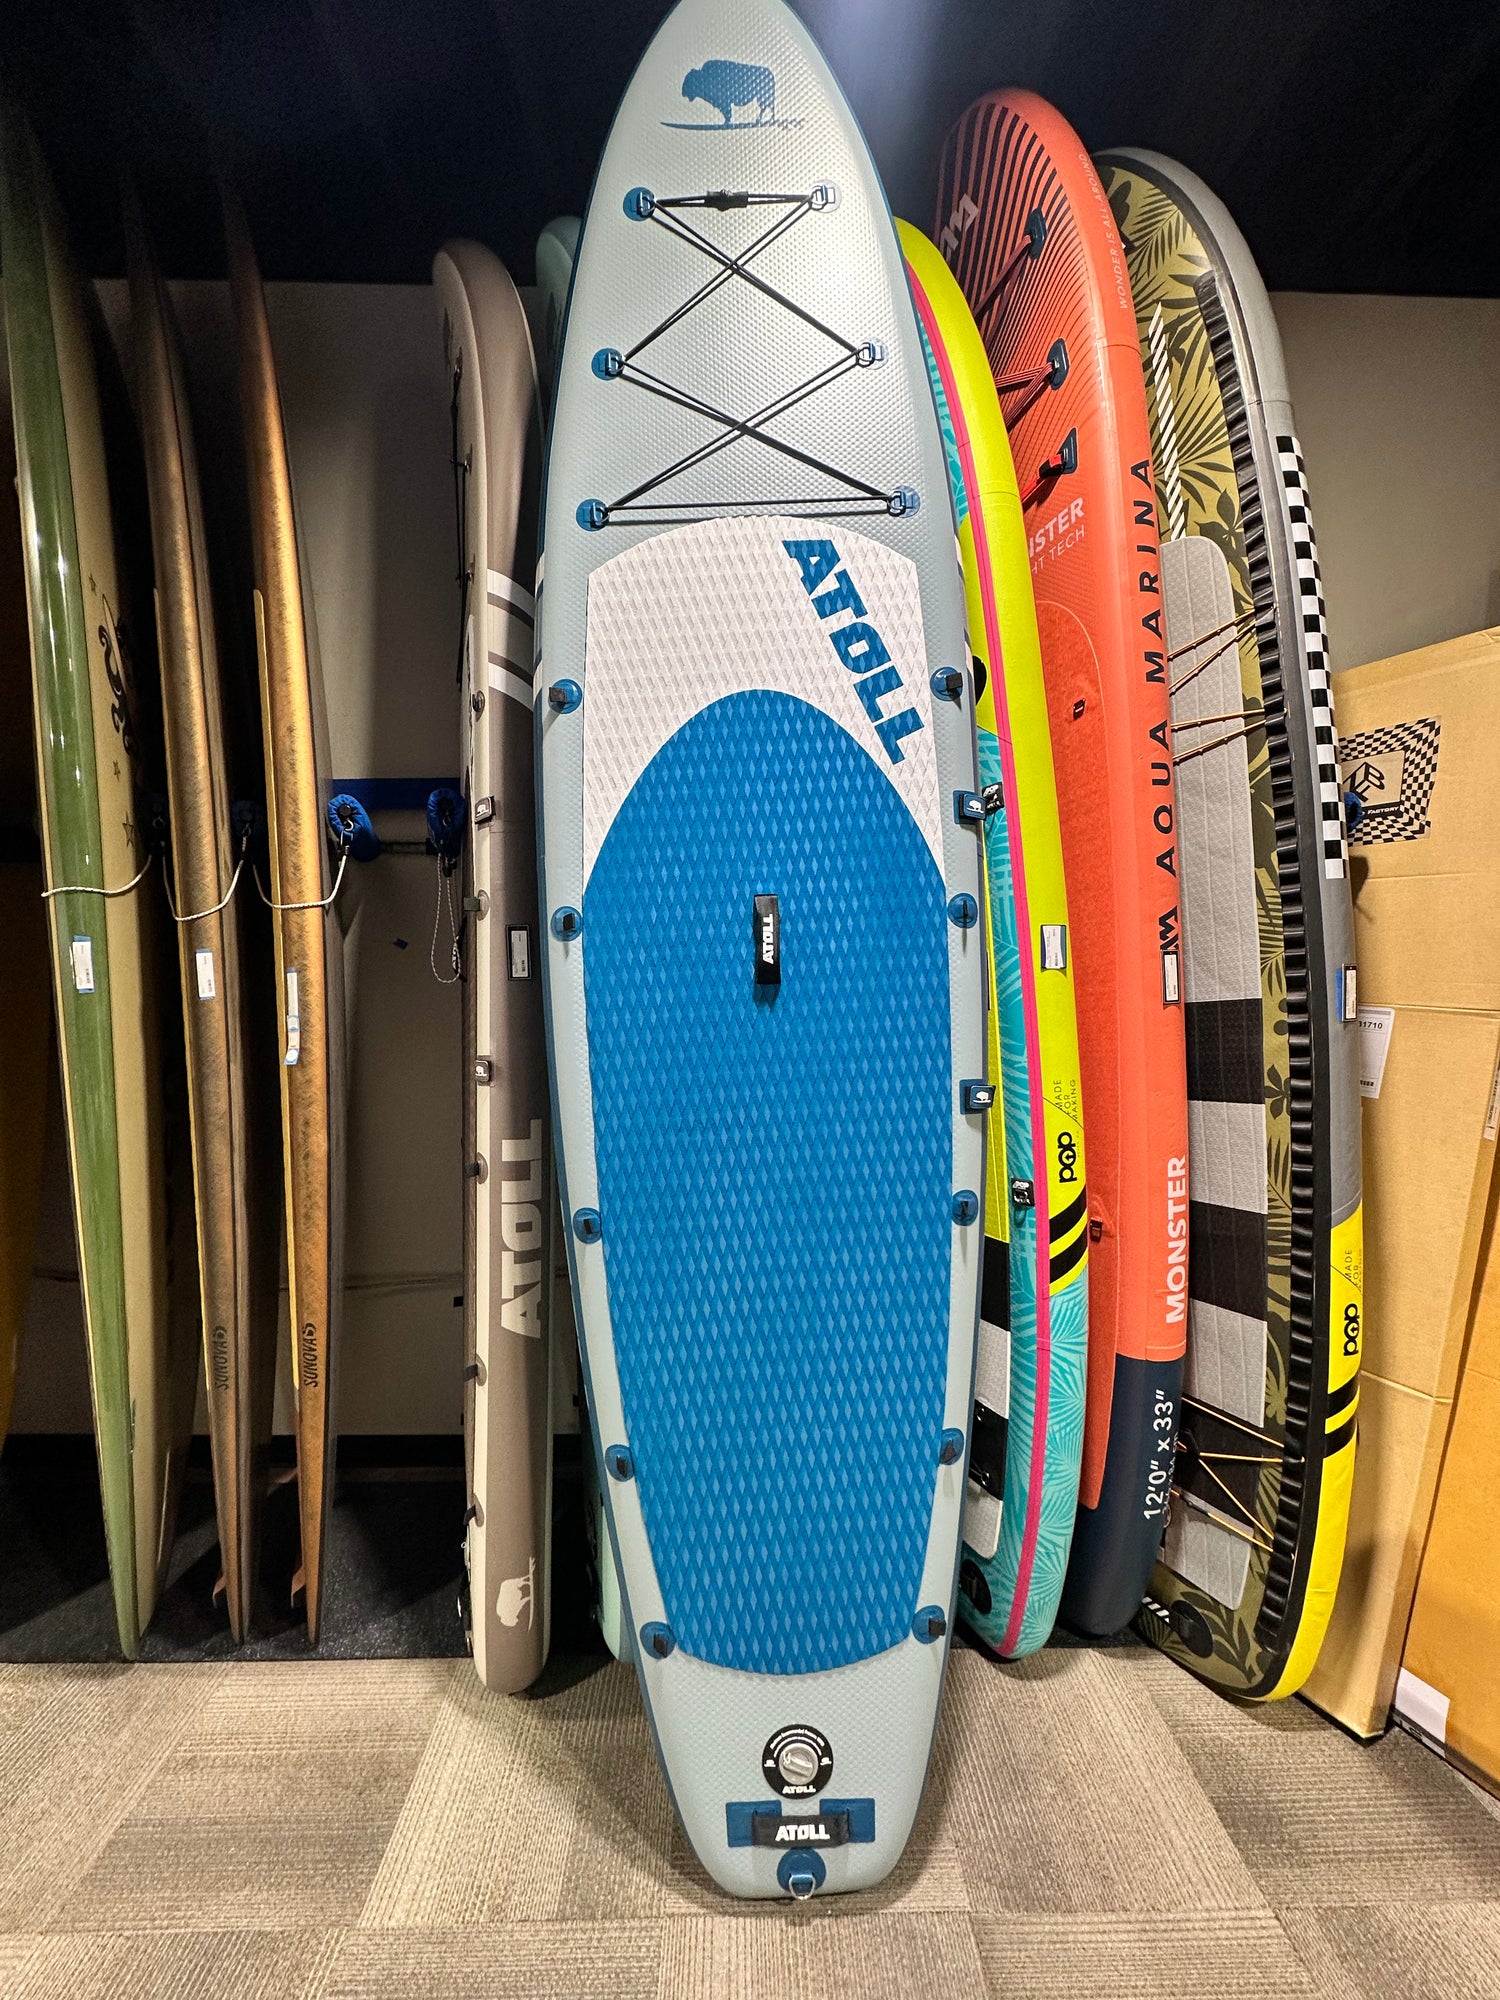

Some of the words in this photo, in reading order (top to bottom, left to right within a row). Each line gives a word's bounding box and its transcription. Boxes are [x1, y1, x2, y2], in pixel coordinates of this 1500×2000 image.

[1104, 231, 1117, 245] IS
[1110, 248, 1128, 310] WONDER
[1028, 497, 1086, 558] STER
[1048, 524, 1086, 561] TECH
[1131, 458, 1168, 685] MARINA
[781, 539, 926, 767] ATOLL
[1149, 719, 1177, 878] AQUA
[1367, 806, 1400, 815] FACTORY
[760, 913, 774, 967] ATOLL
[500, 1118, 545, 1339] ATOLL
[1165, 1157, 1187, 1324] MONSTER
[213, 1341, 229, 1391] SUNOVA
[302, 1338, 319, 1388] SUNOVA
[1157, 1436, 1171, 1452] x
[782, 1785, 816, 1795] ATOLL
[775, 1823, 831, 1841] ATOLL
